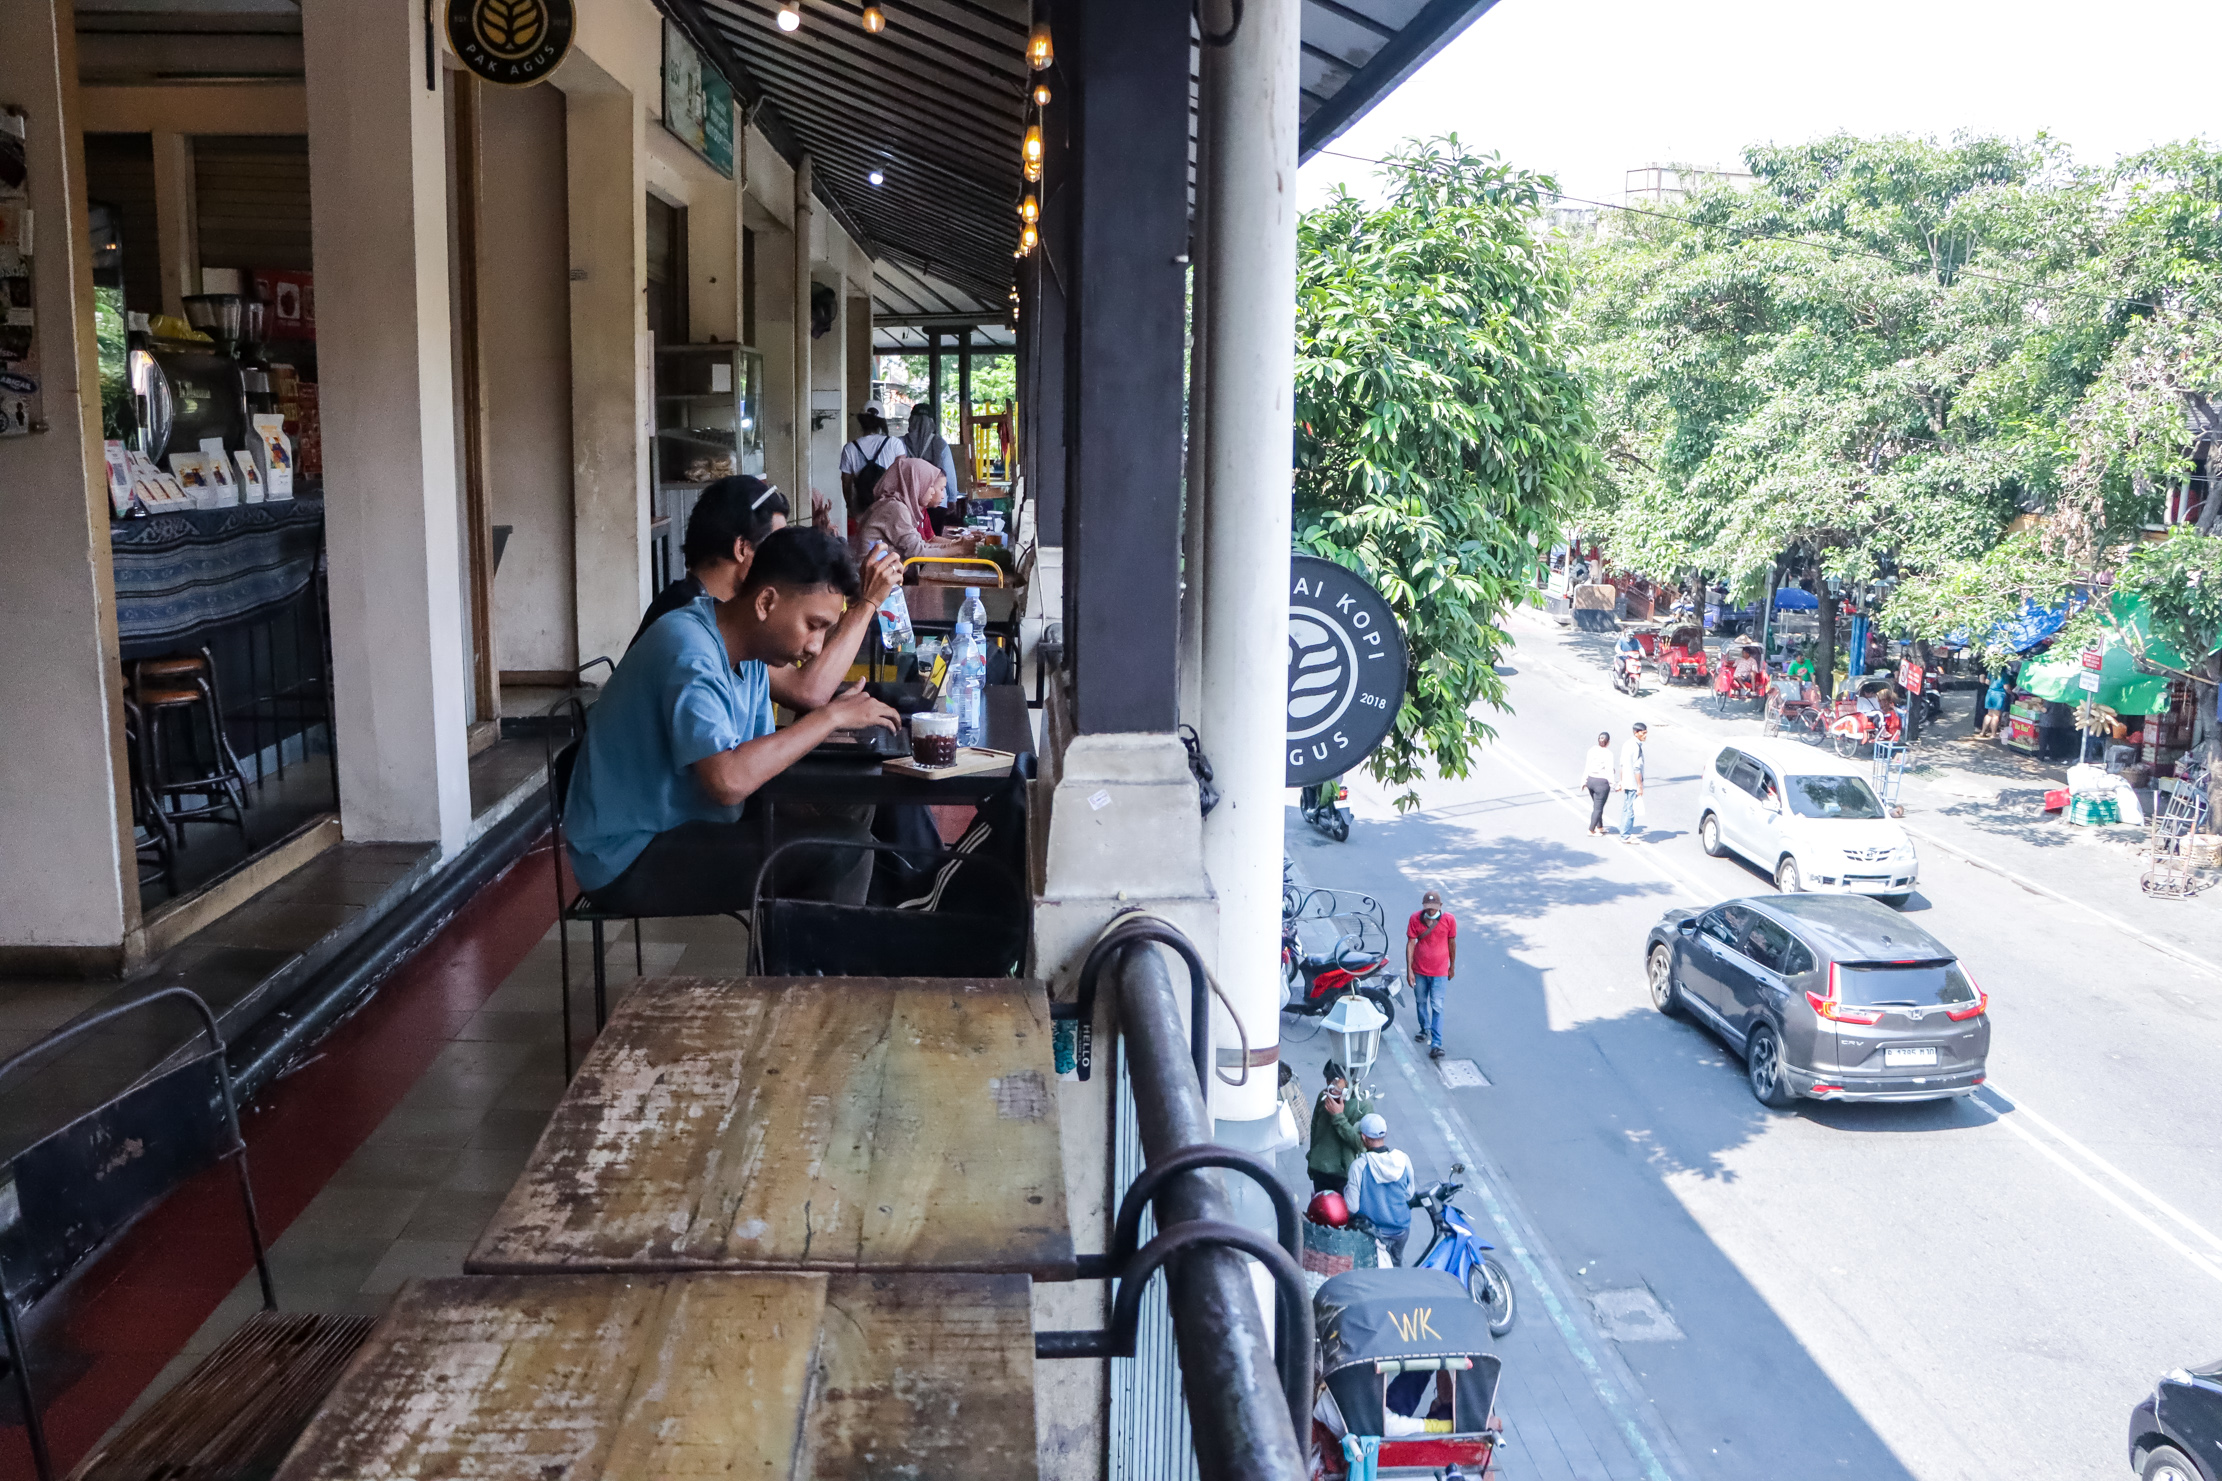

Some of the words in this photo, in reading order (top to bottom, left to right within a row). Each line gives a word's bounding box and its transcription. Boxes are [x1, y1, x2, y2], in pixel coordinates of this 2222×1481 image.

[466, 44, 498, 72] PAK
[510, 45, 555, 75] AGUS
[1293, 577, 1324, 598] AI
[1336, 593, 1385, 660] KOPI
[1360, 692, 1387, 709] 2018
[1289, 731, 1349, 766] GUS
[1082, 1024, 1091, 1067] HELLO
[1387, 1307, 1443, 1342] WK
